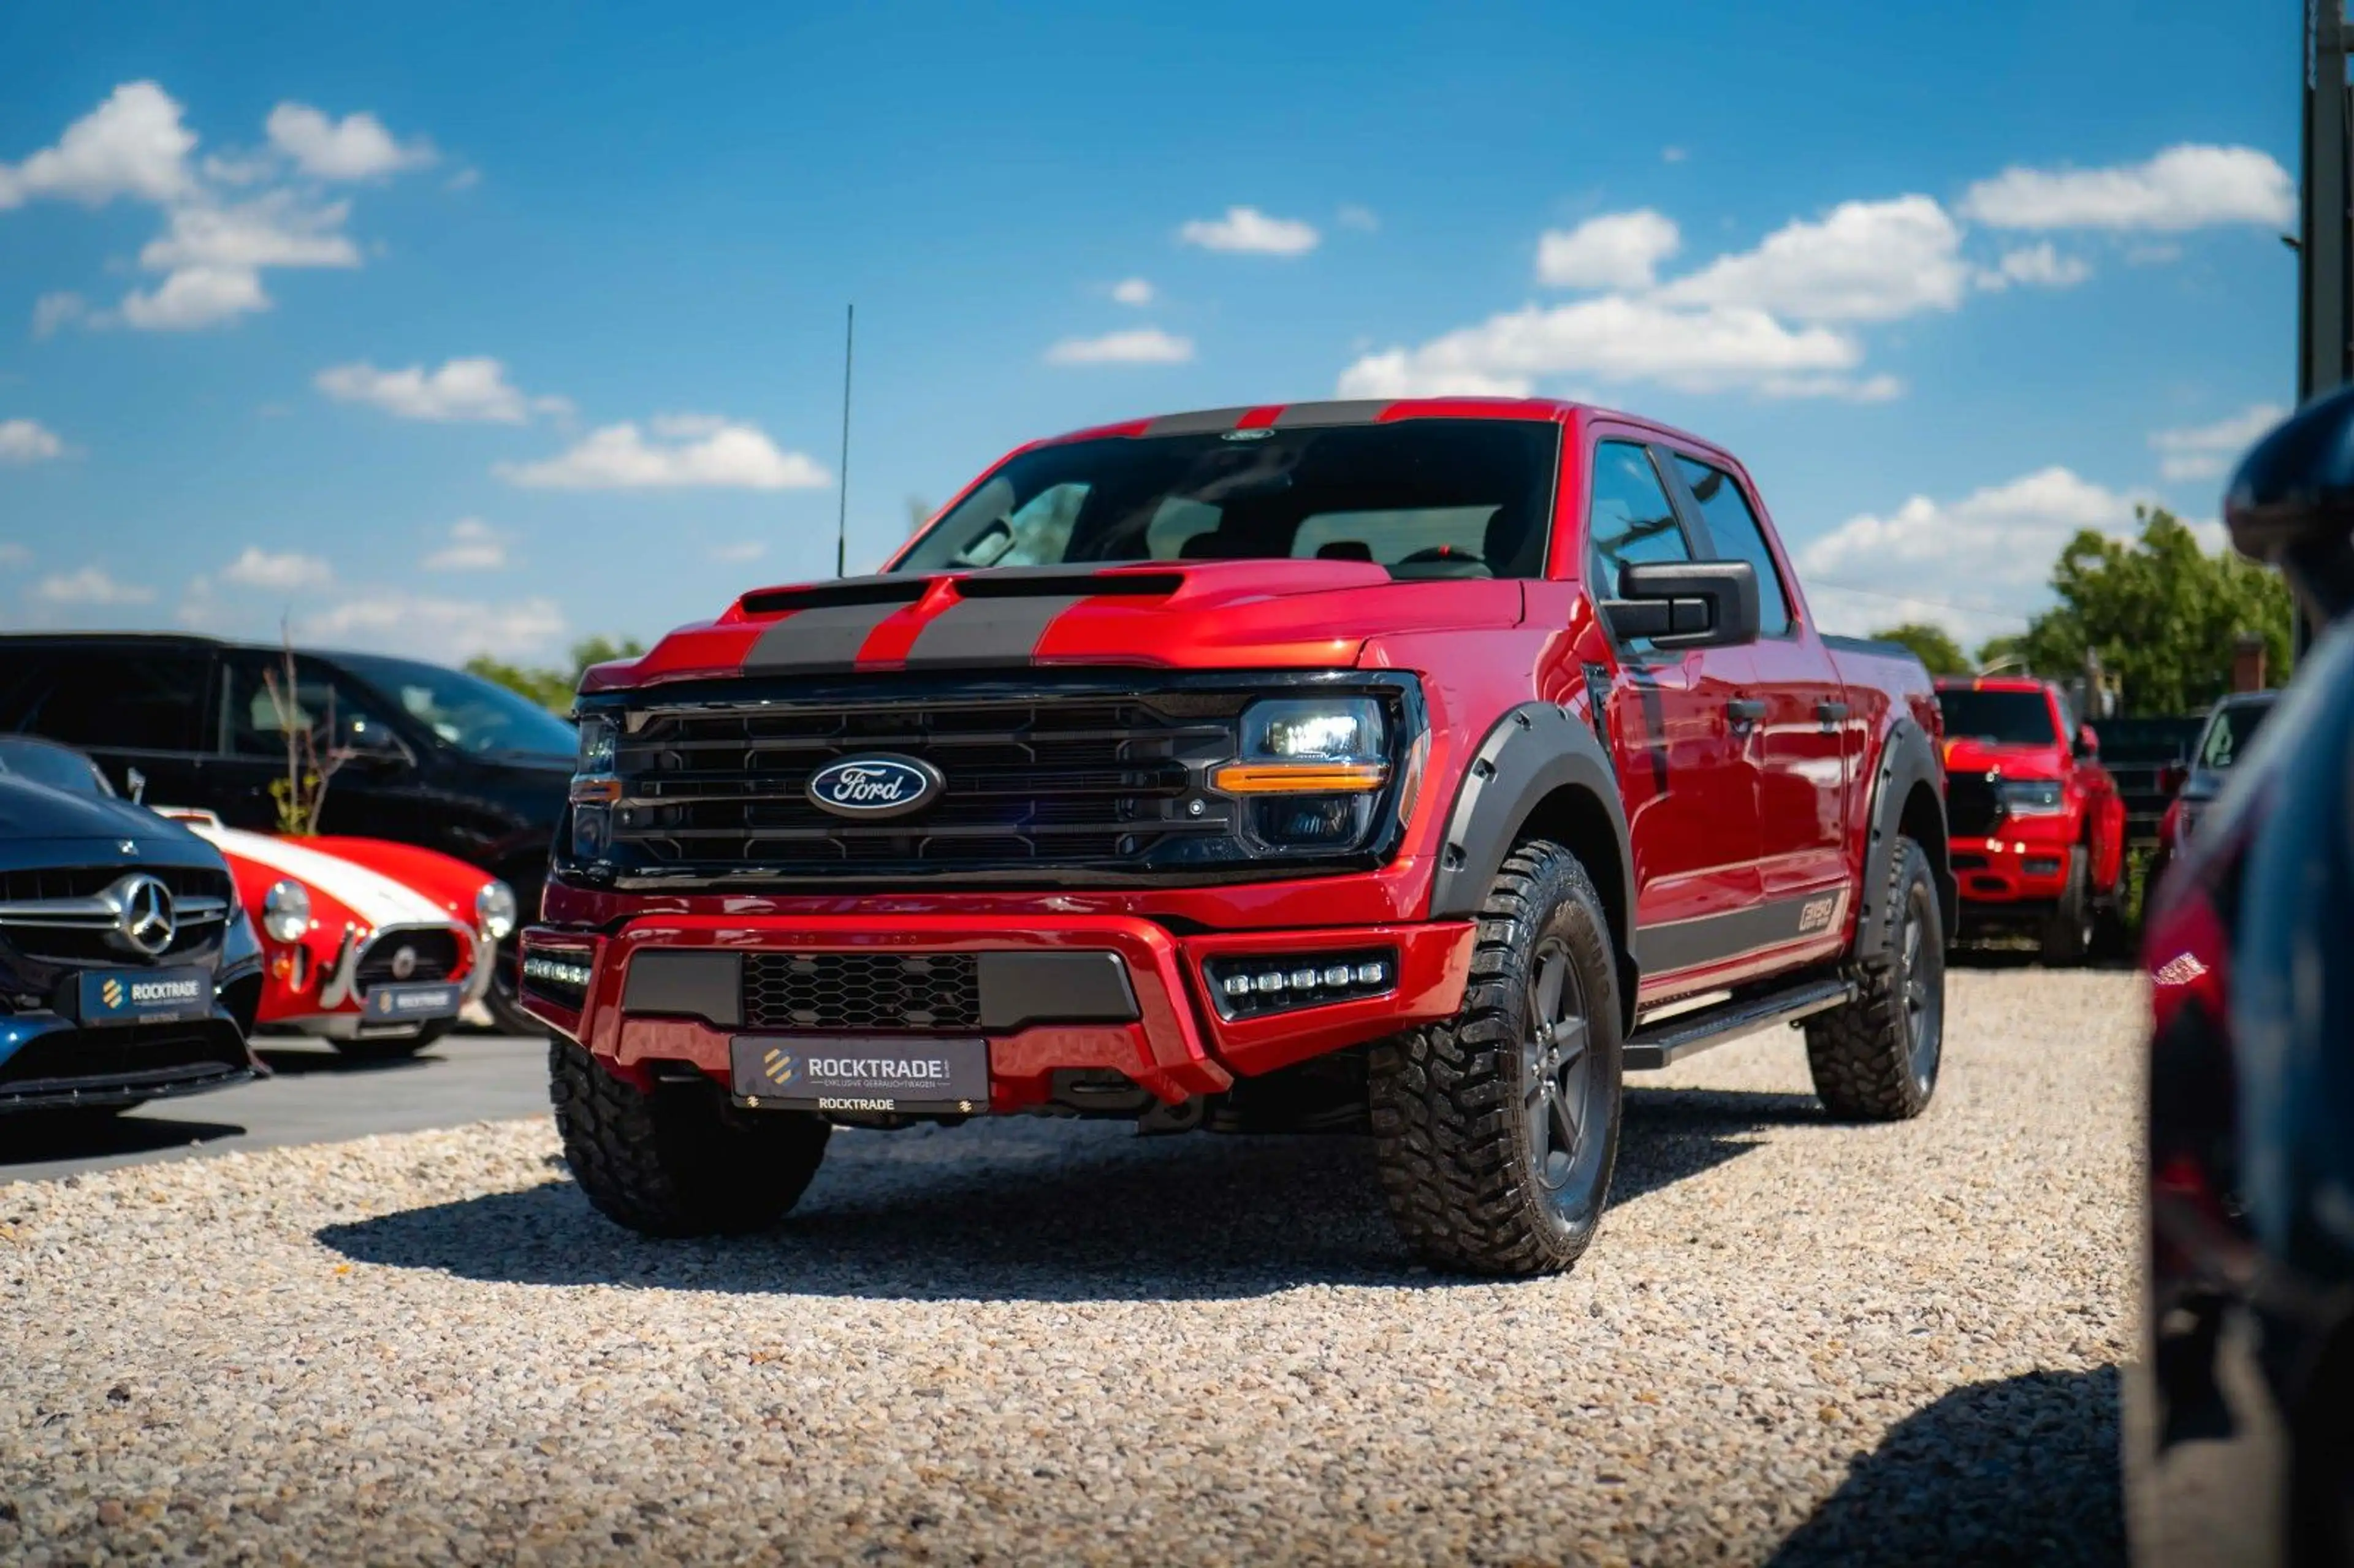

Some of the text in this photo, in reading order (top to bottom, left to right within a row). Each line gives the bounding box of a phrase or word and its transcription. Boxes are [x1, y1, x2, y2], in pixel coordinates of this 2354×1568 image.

[833, 767, 904, 801] Ford
[809, 1059, 943, 1078] ROCKTRADE
[819, 1097, 895, 1111] ROCKTRADE
